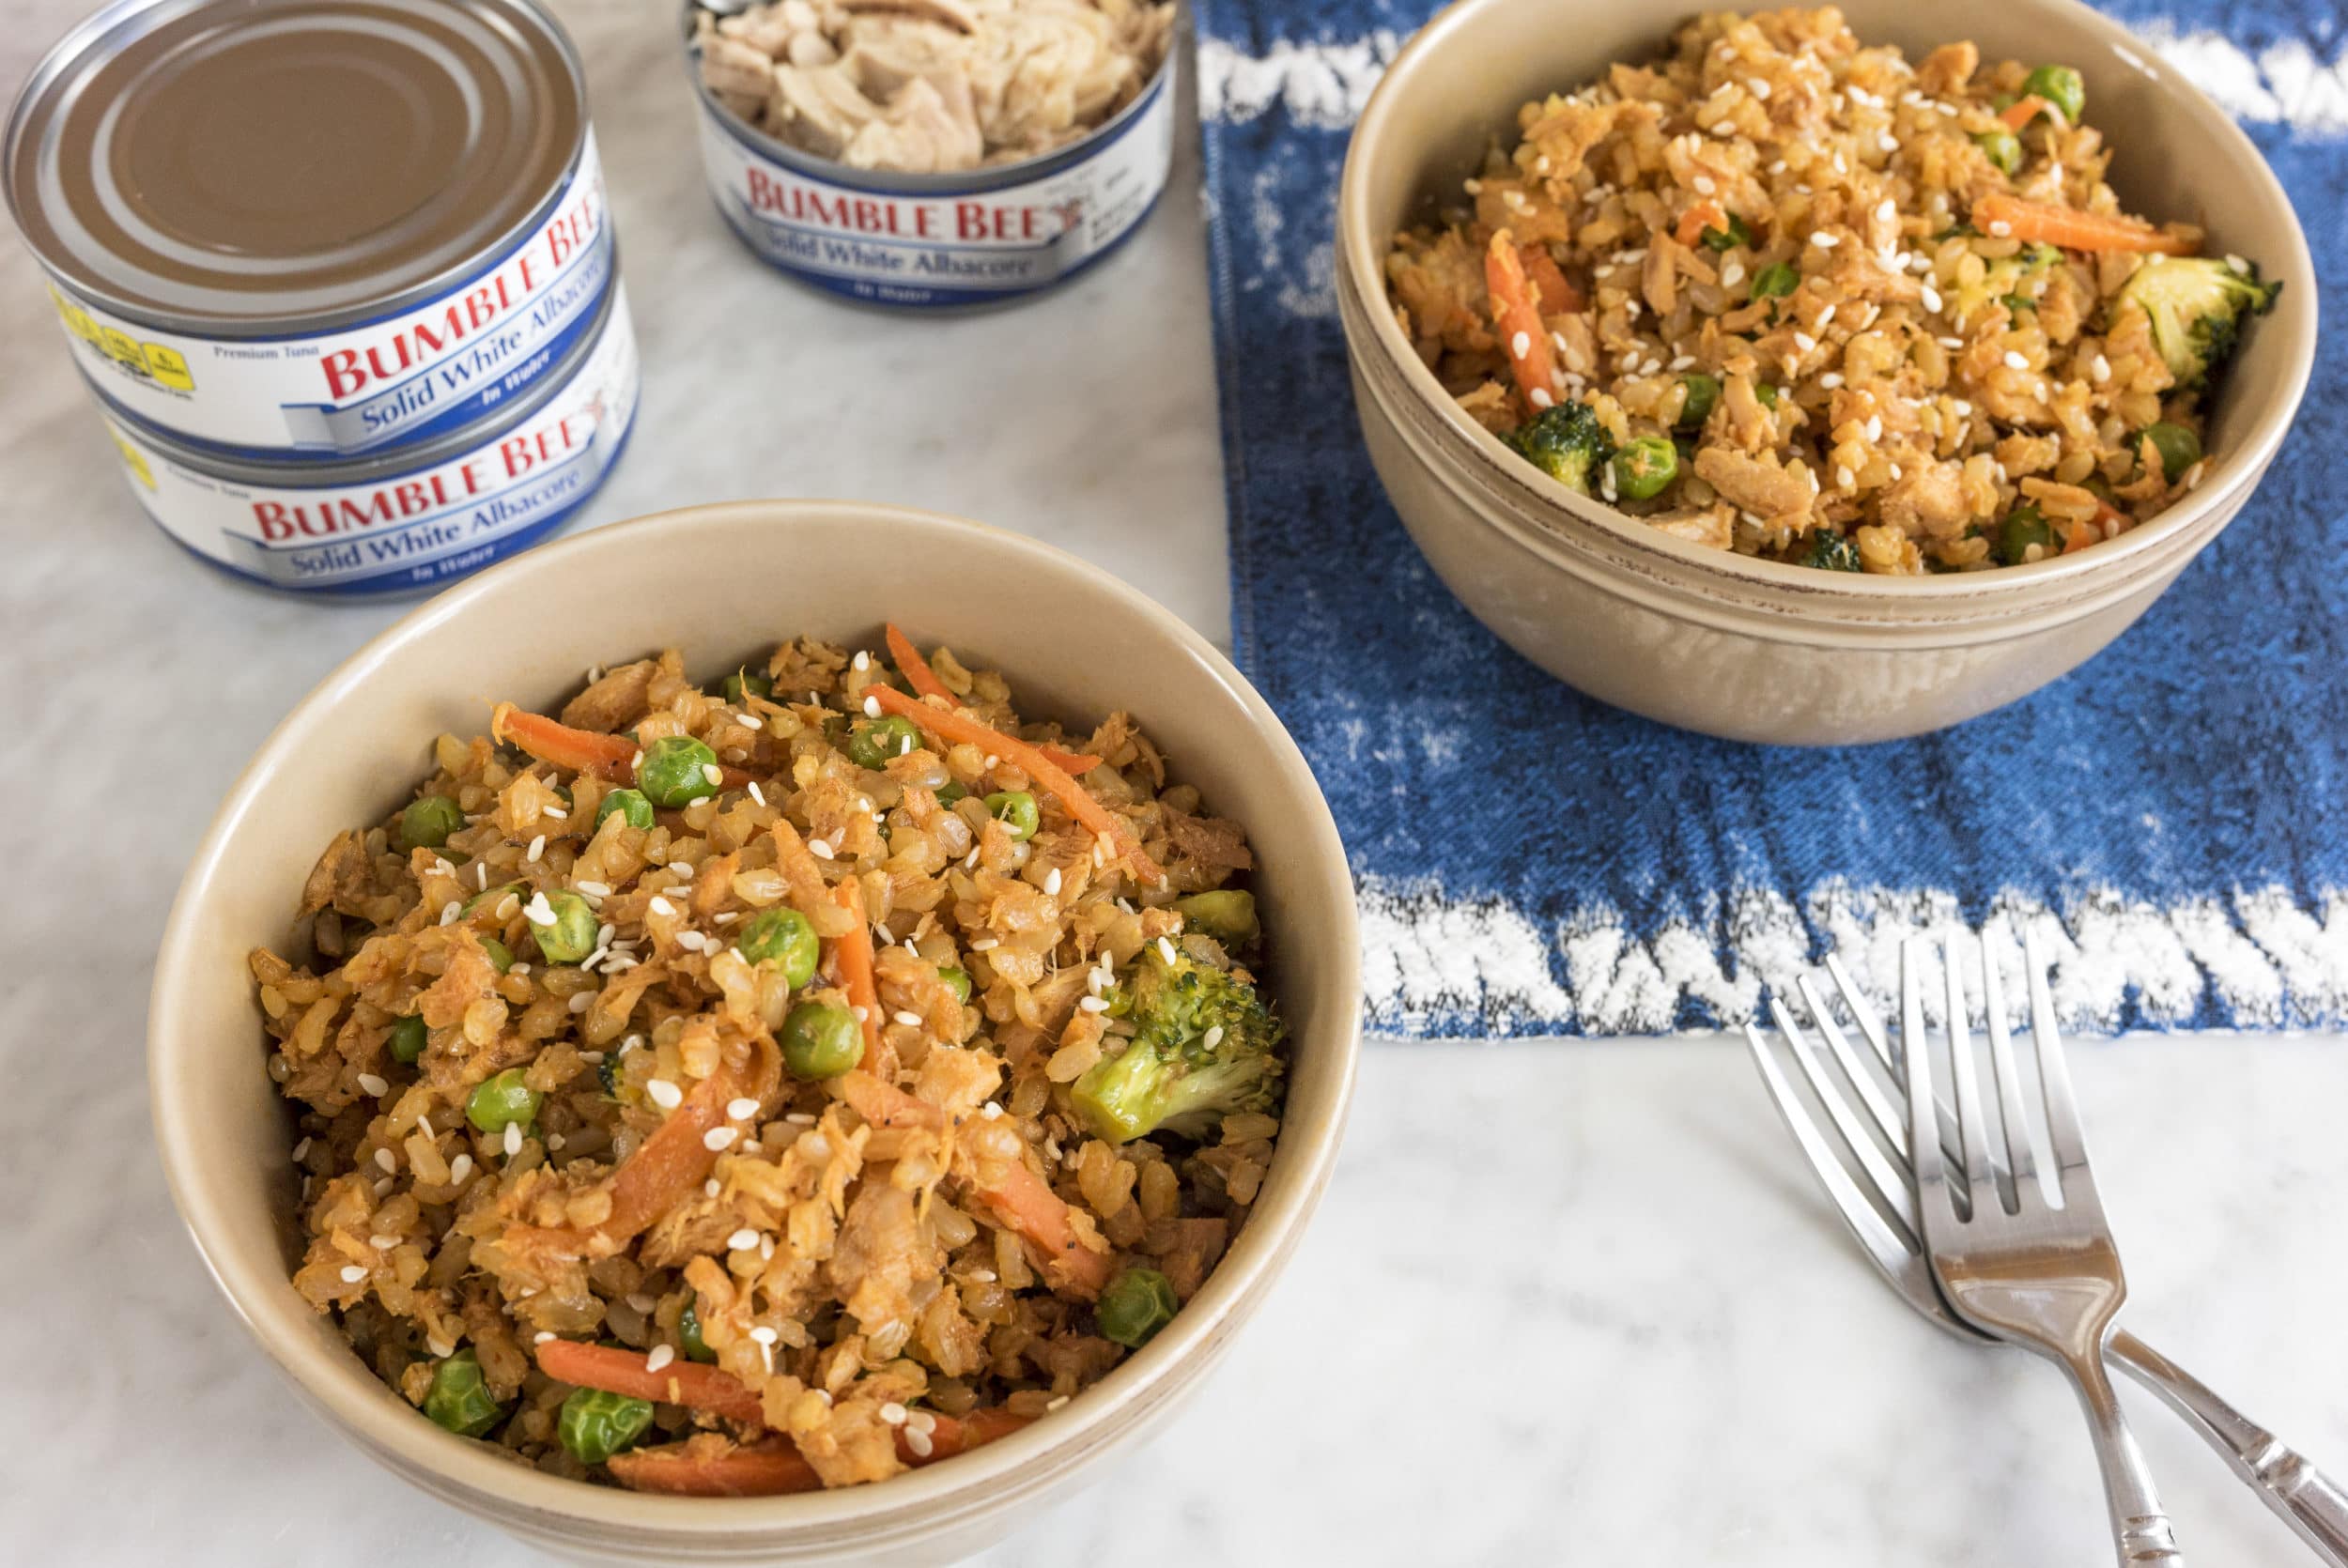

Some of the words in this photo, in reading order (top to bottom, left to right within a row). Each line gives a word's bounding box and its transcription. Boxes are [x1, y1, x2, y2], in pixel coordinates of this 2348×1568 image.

[747, 166, 941, 240] BUMBLE
[955, 201, 1043, 240] BEE
[824, 237, 904, 269] White
[320, 247, 544, 400] BUMBLE
[547, 192, 599, 268] BEE
[362, 378, 436, 431] Solid
[440, 331, 522, 389] White
[531, 254, 601, 334] Albacore
[213, 346, 279, 360] Premium
[285, 346, 319, 358] Tuna
[253, 457, 492, 541] BUMBLE
[501, 413, 579, 479] BEE
[290, 543, 362, 574] Solid
[369, 525, 460, 561] White
[471, 469, 580, 532] Albacore
